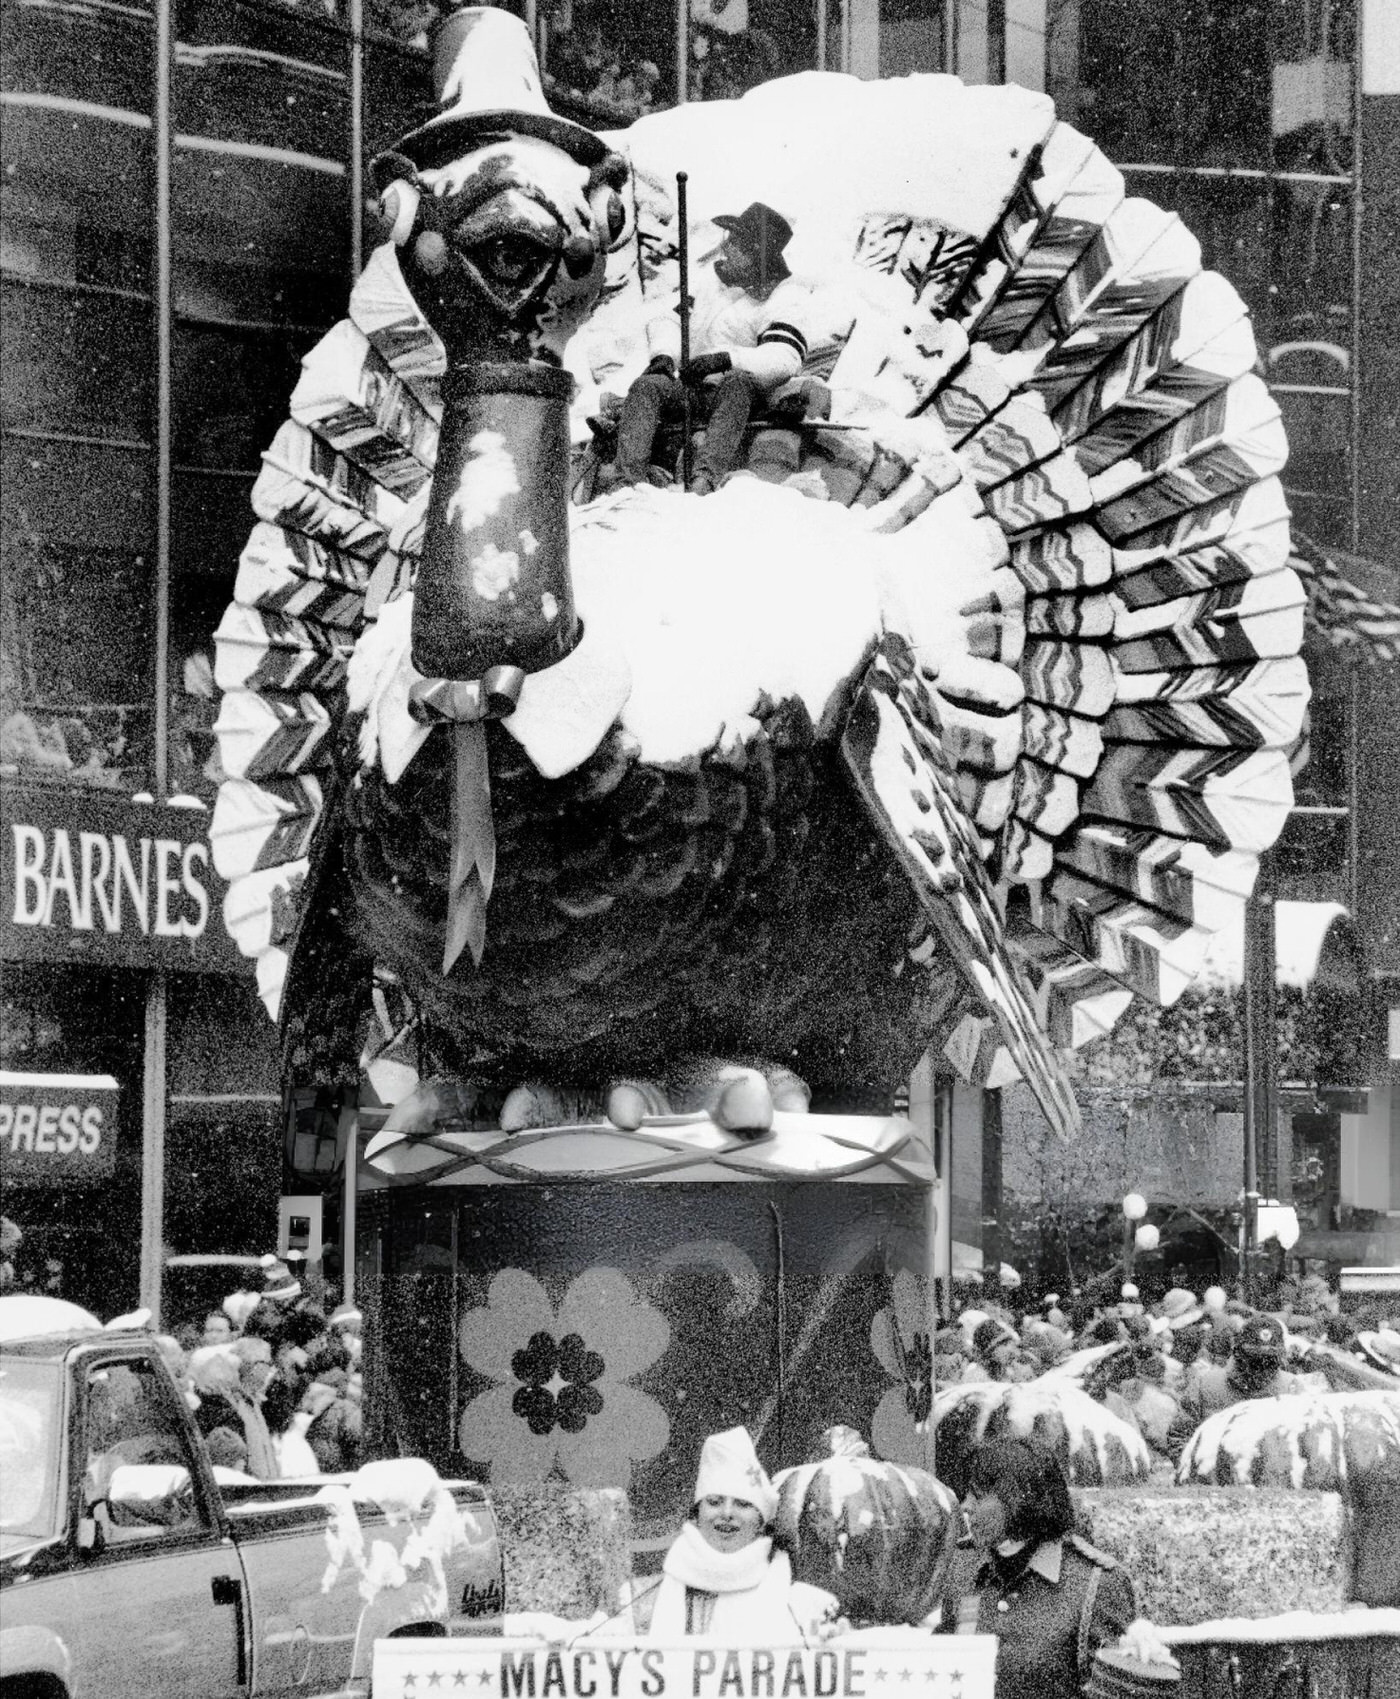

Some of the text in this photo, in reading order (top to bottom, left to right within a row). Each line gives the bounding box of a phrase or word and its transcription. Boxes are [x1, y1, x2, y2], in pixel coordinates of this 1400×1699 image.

[12, 824, 209, 938] BARNES
[501, 1650, 867, 1697] MACY'S PARADE
